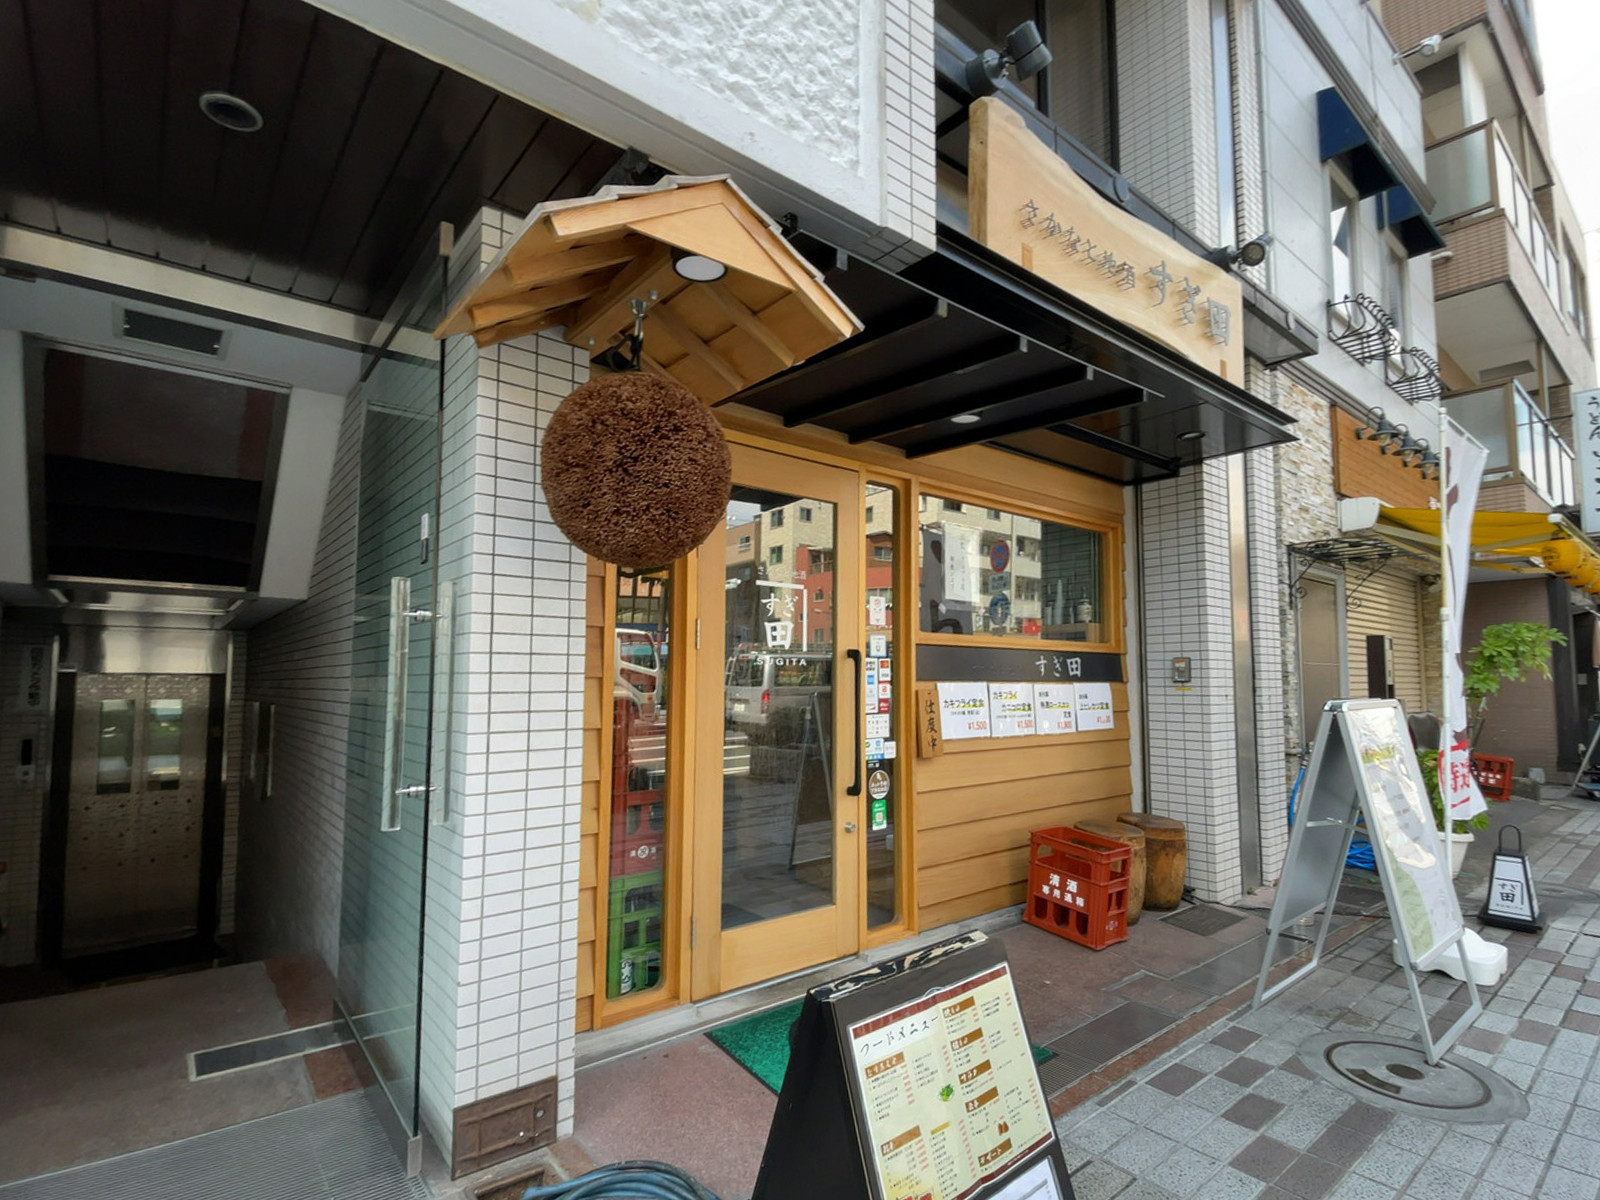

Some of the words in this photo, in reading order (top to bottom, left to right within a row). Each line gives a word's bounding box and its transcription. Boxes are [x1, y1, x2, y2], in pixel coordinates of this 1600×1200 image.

[1145, 259, 1231, 347] すぎ田
[756, 656, 808, 667] SUGITA
[1035, 656, 1083, 678] すぎ田
[1049, 872, 1079, 894] 清酒
[860, 1016, 939, 1058] フードメニュー
